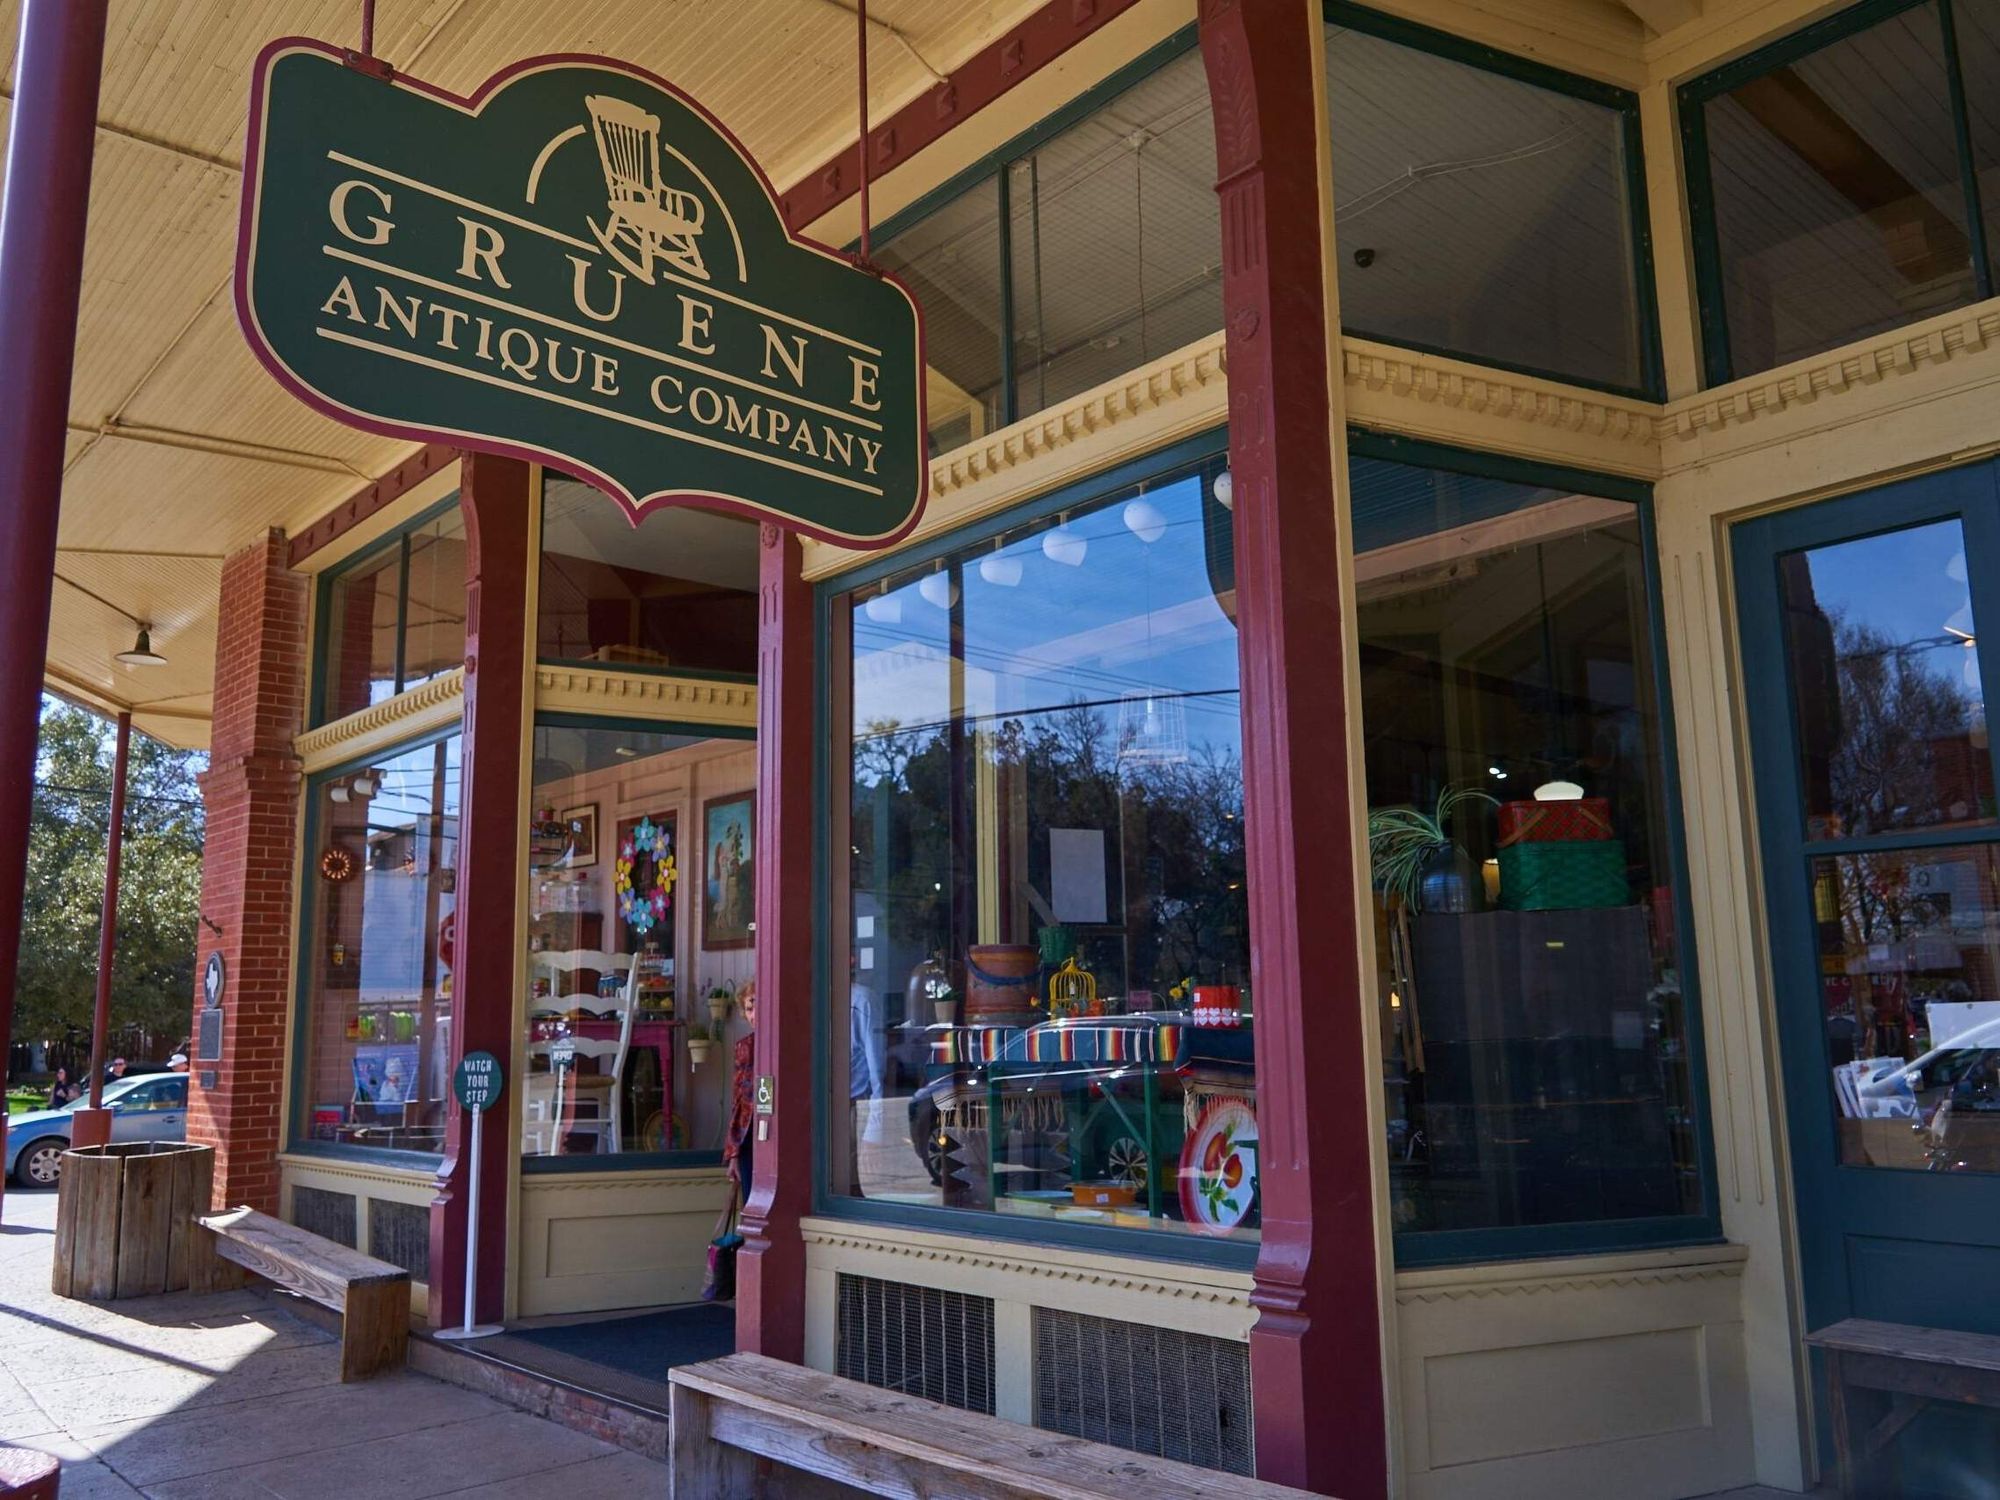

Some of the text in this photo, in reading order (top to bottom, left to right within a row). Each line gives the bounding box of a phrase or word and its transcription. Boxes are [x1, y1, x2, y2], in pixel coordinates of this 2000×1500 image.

[328, 179, 882, 412] GRUENE
[320, 275, 883, 476] ANTIQUE COMPANY
[464, 1059, 492, 1073] WATCH
[466, 1075, 489, 1088] YOUR
[465, 1090, 488, 1104] STEP
